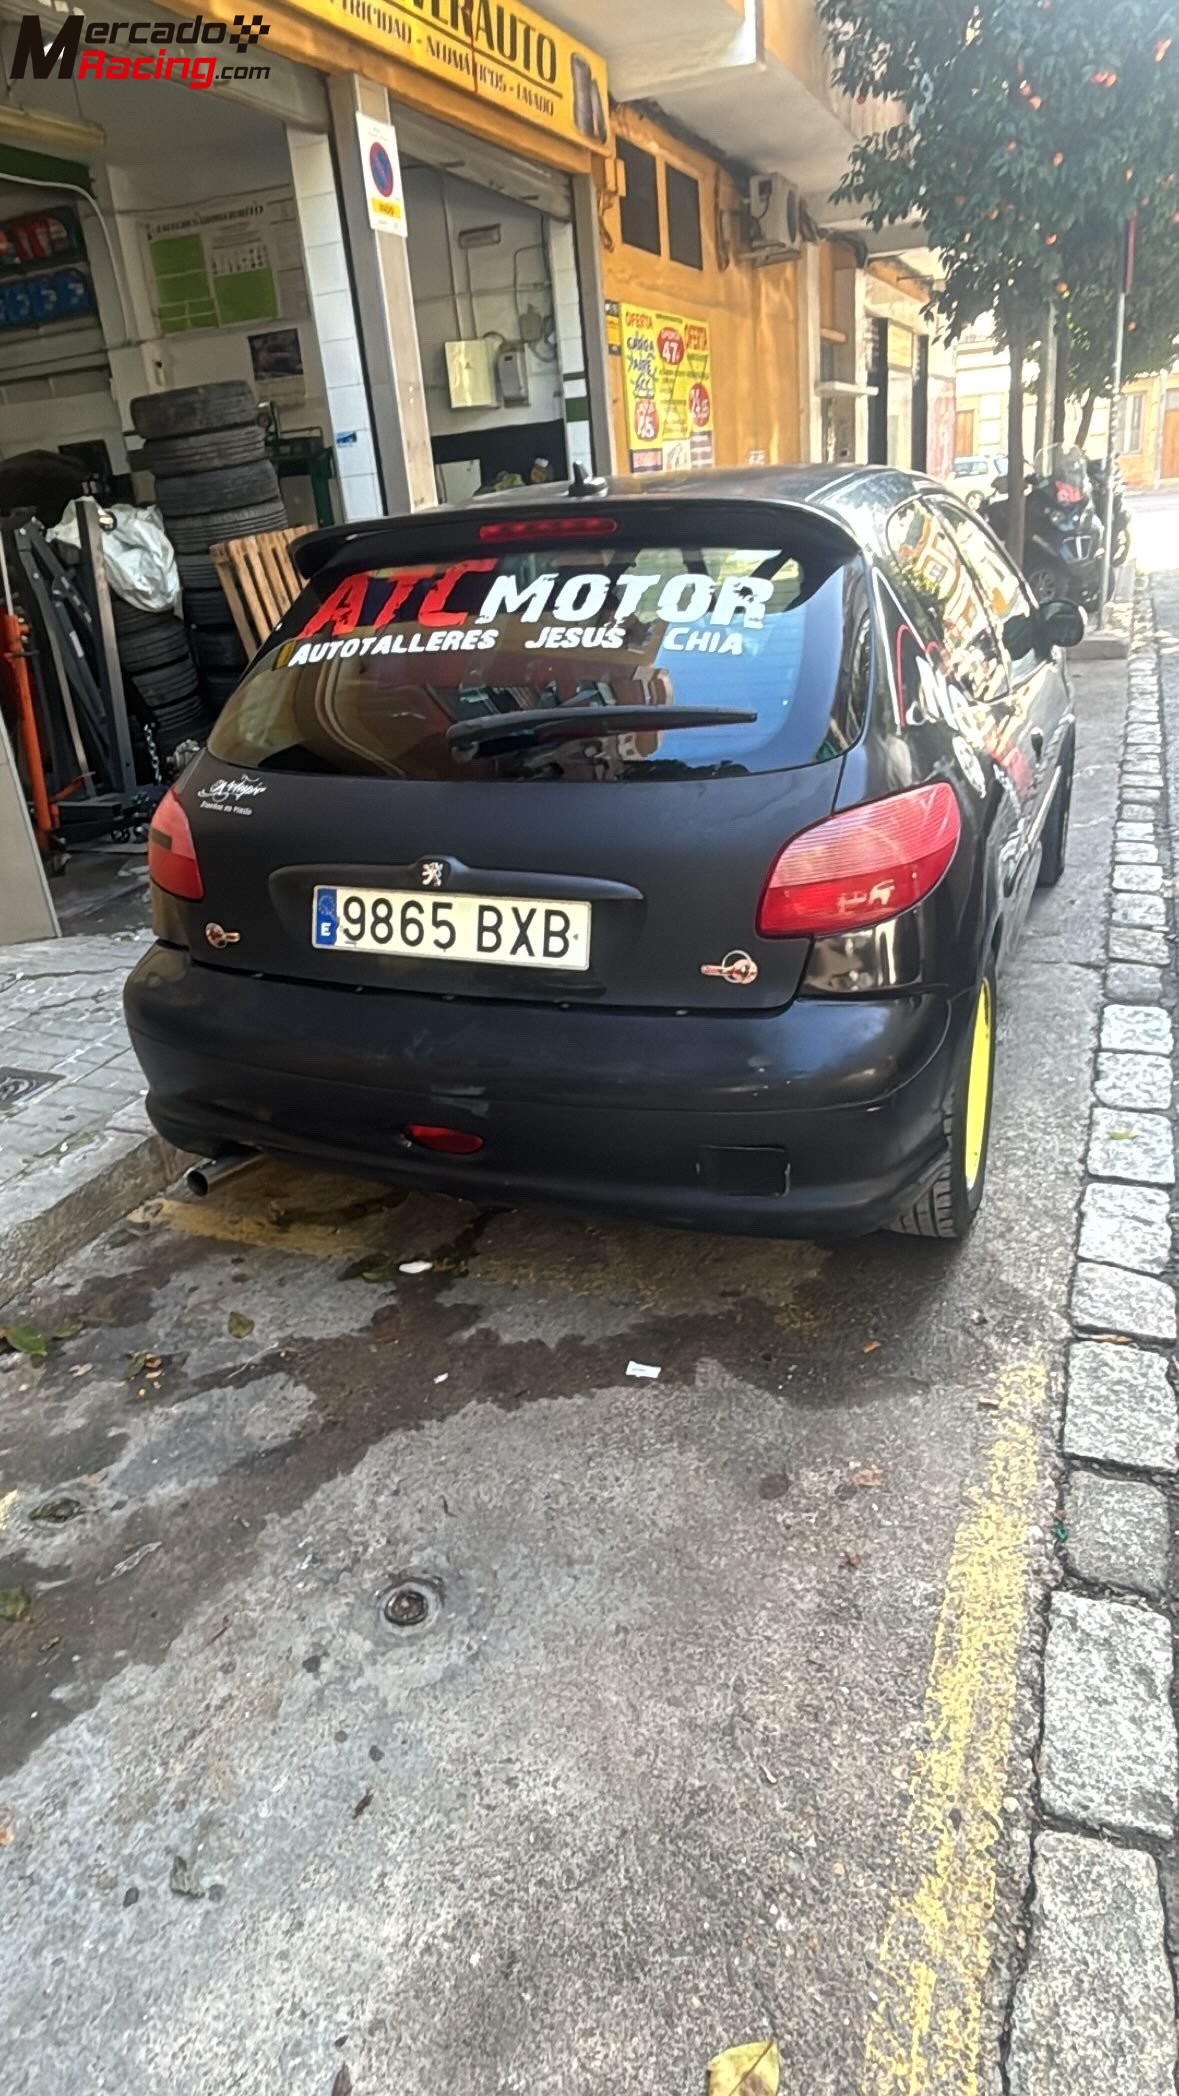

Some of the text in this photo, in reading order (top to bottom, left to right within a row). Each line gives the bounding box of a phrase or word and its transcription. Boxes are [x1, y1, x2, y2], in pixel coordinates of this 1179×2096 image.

[516, 83, 554, 116] LAVADO
[626, 311, 653, 329] OFERTA
[475, 573, 775, 629] MOTOR
[288, 628, 499, 667] AUTOTALLERES
[662, 627, 743, 655] CHIA
[320, 922, 331, 936] E
[342, 896, 571, 959] 9865 BXB
